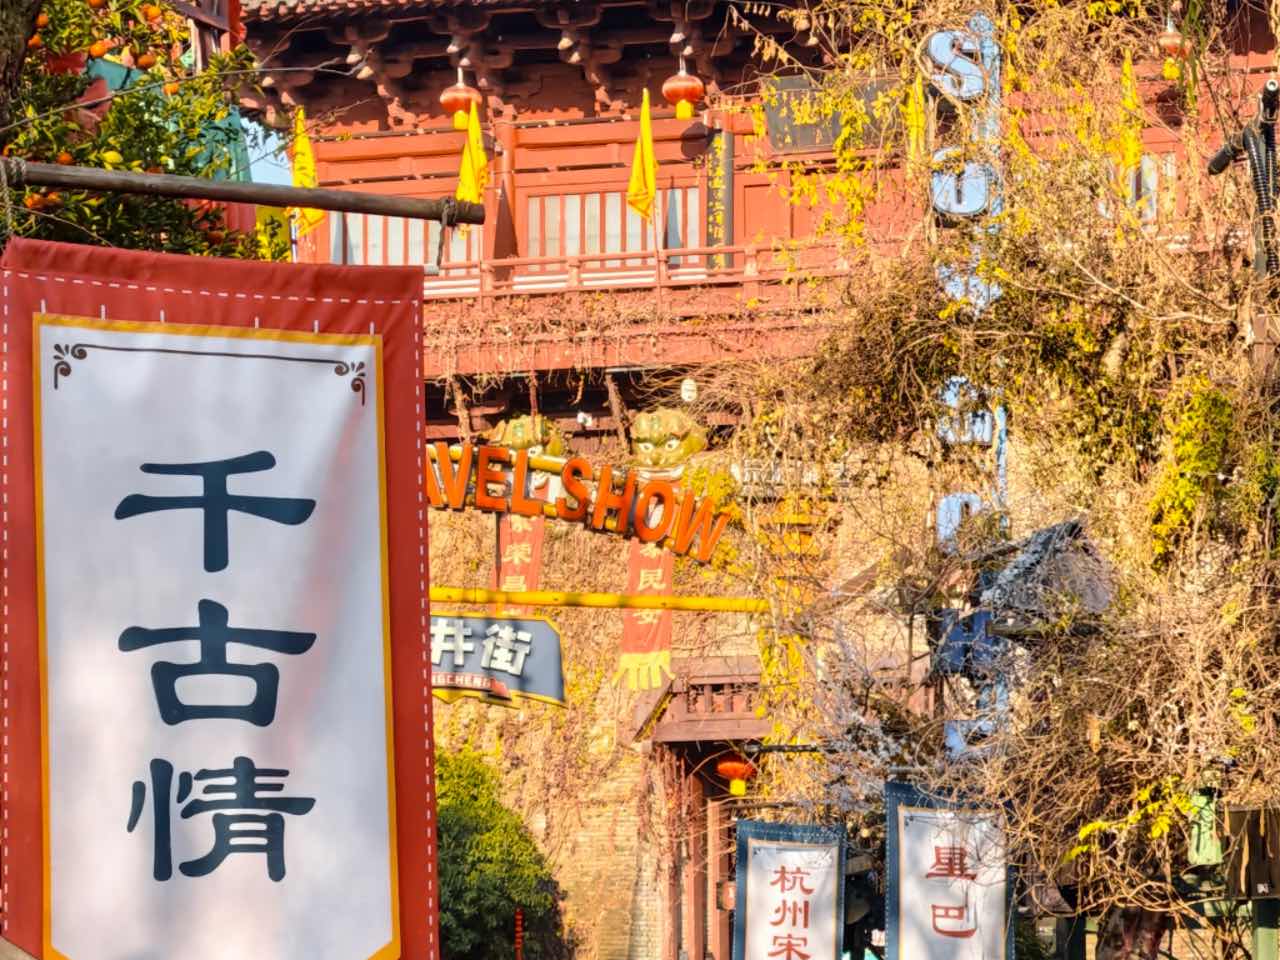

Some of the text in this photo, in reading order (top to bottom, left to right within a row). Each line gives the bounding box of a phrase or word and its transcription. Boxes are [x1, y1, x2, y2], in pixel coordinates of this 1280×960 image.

[557, 457, 731, 562] SHOW
[115, 451, 317, 882] 千古情
